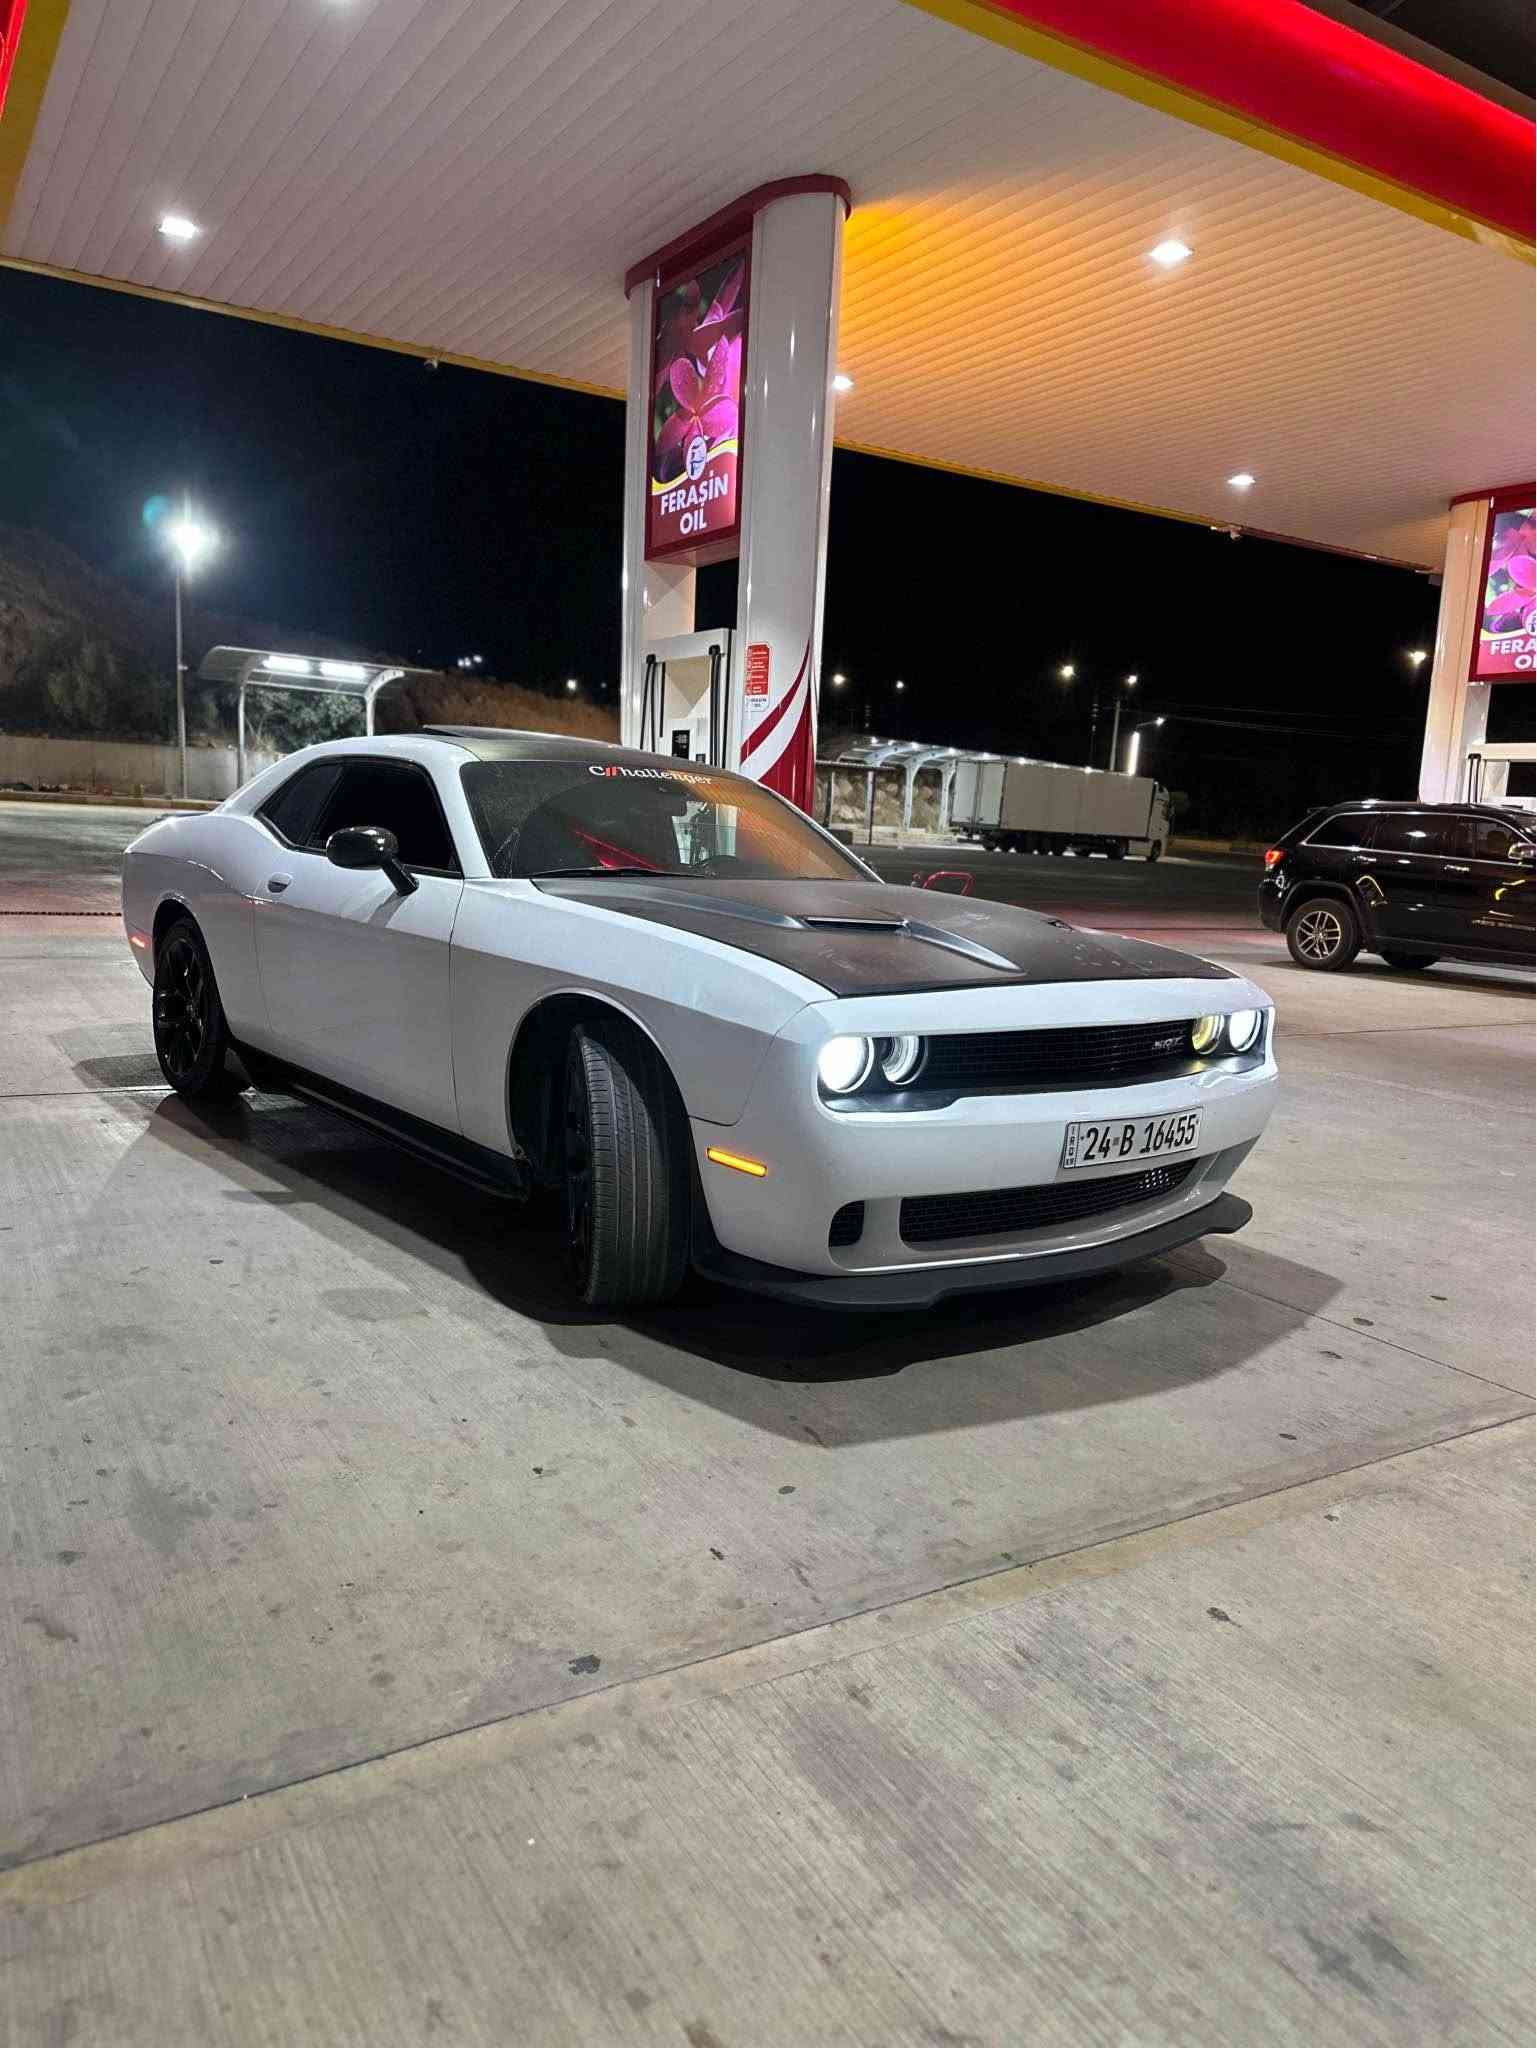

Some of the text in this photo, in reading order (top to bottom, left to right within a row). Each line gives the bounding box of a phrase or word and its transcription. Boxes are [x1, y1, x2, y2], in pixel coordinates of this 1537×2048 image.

[679, 508, 707, 535] OIL
[1083, 1114, 1197, 1161] 24 B 16455
